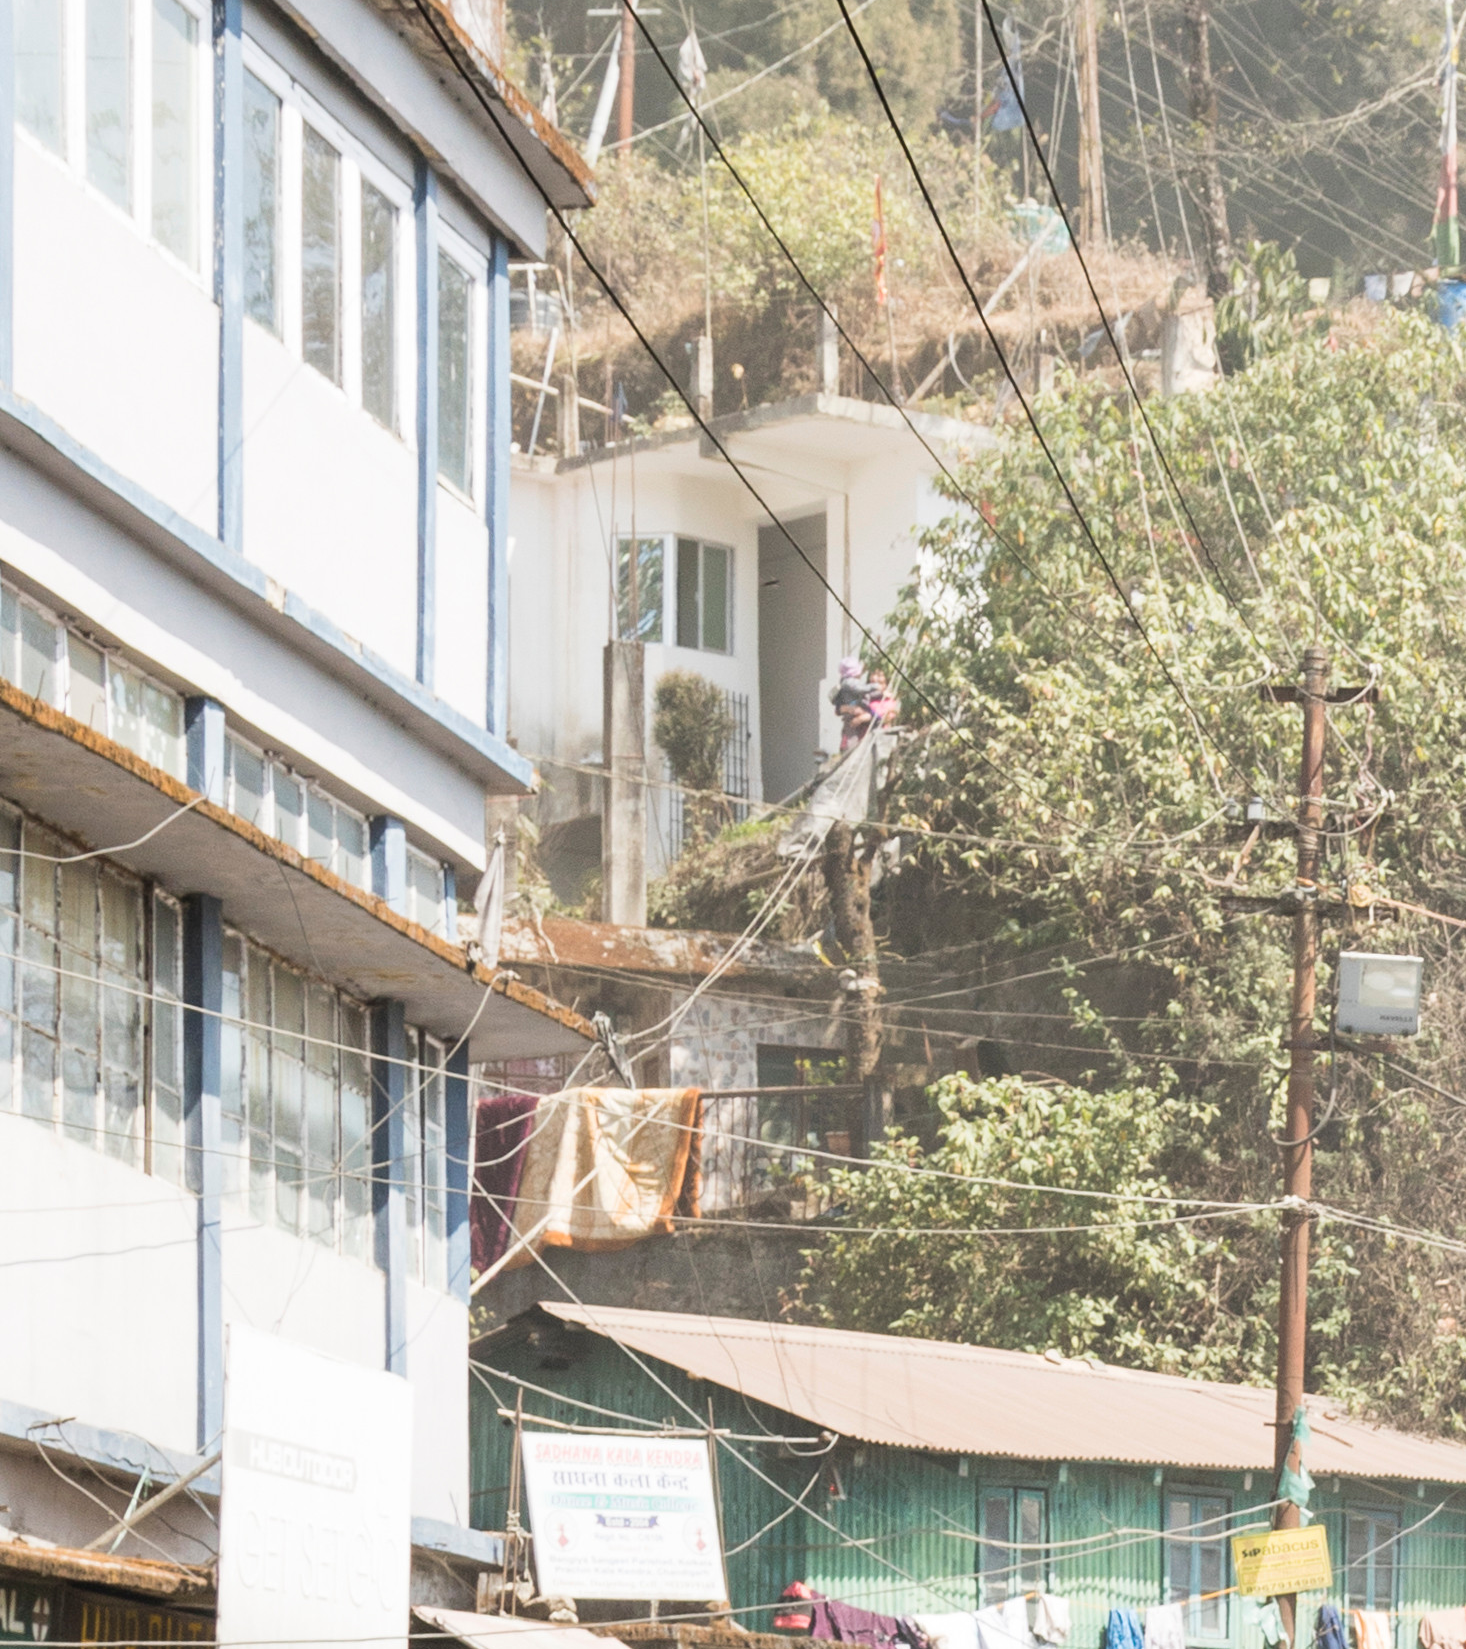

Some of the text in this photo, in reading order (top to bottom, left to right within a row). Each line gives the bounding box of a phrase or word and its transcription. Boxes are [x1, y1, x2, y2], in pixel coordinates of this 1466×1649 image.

[535, 1443, 703, 1470] SADHANA KALA KENDRA
[613, 1472, 651, 1490] कला
[236, 1509, 291, 1594] GET
[299, 1521, 346, 1604] SET
[1262, 1539, 1319, 1555] abacus
